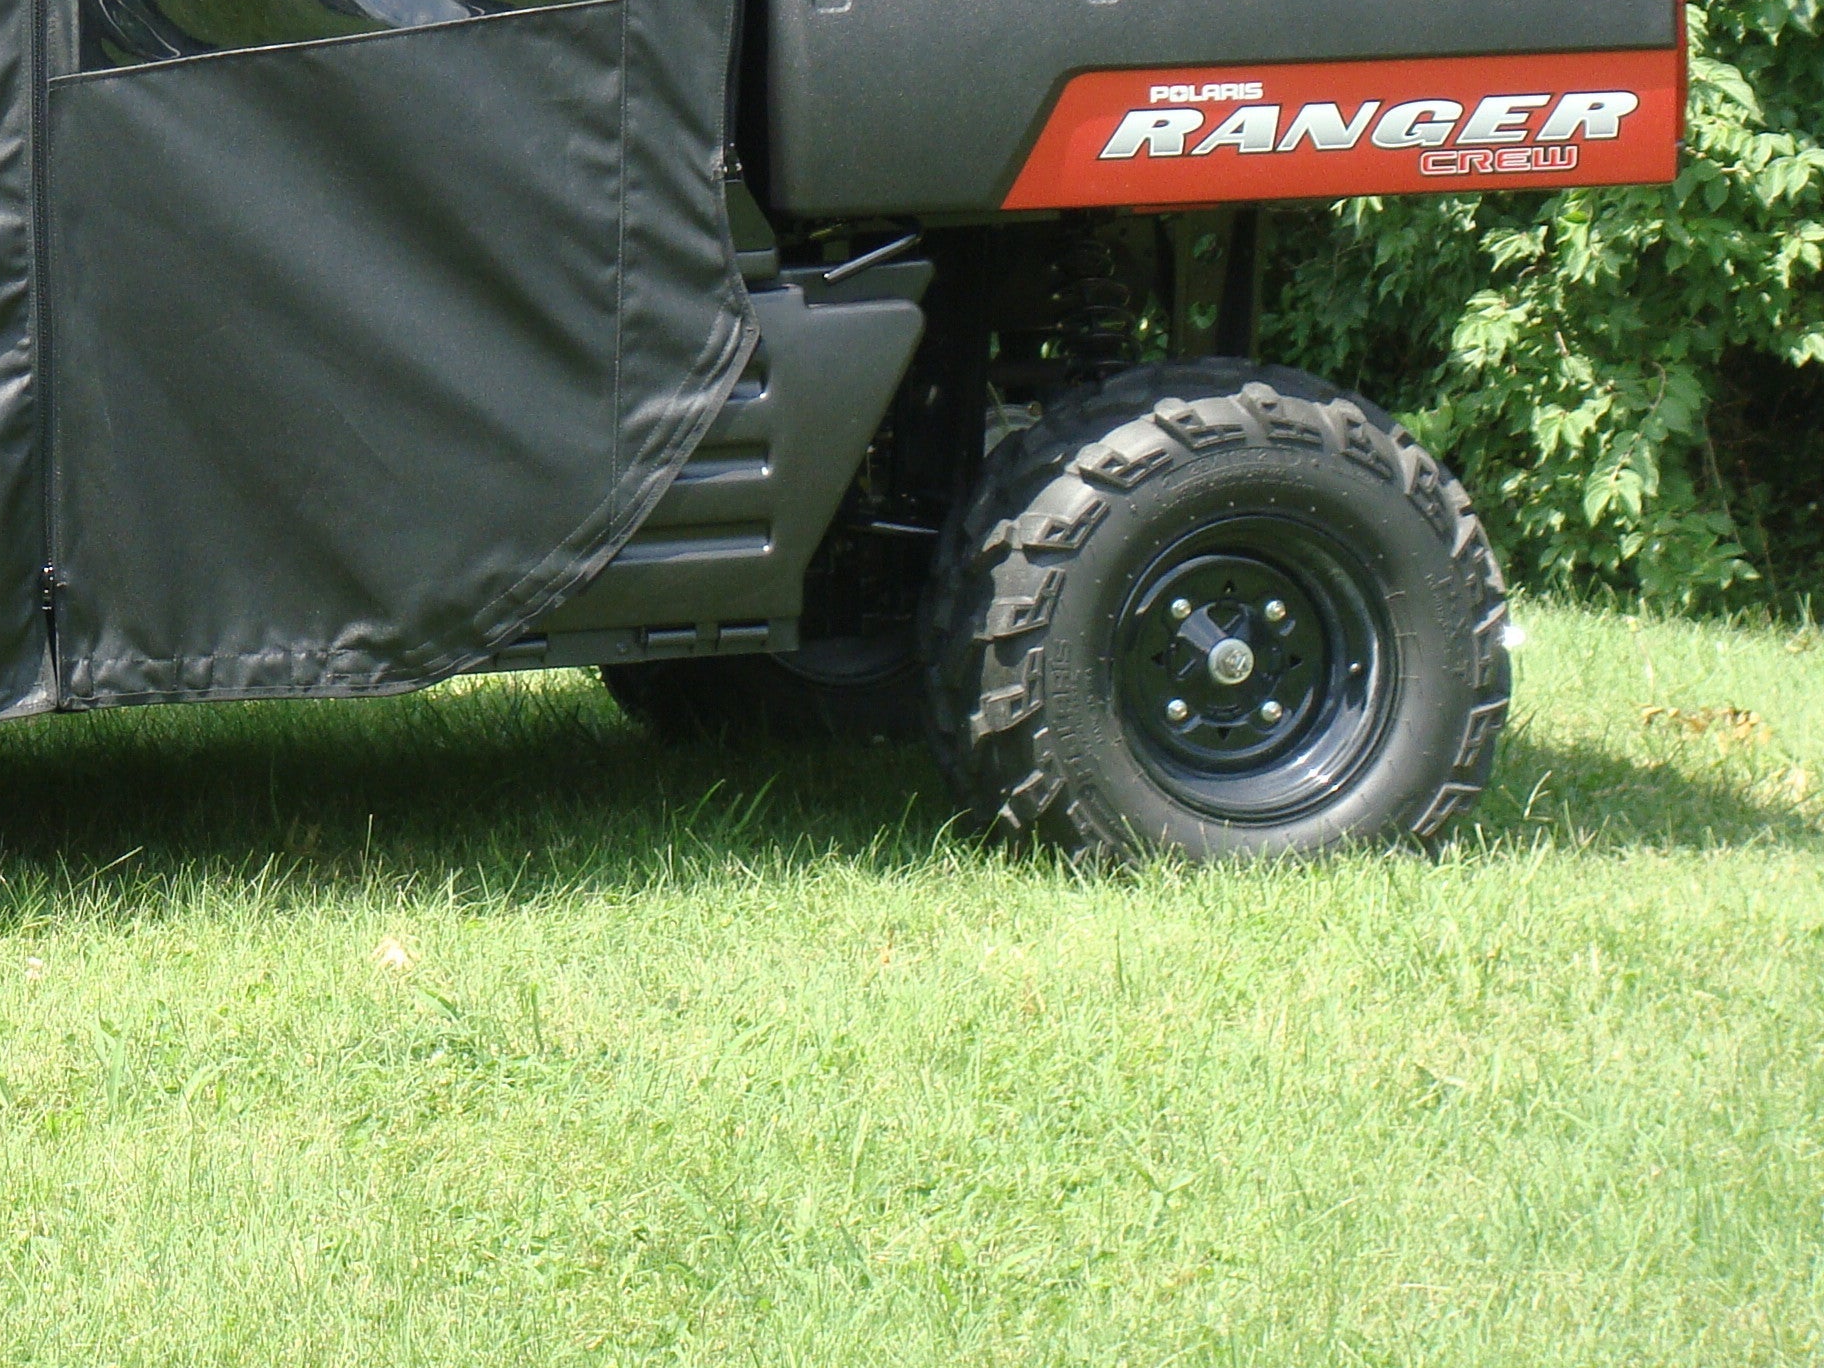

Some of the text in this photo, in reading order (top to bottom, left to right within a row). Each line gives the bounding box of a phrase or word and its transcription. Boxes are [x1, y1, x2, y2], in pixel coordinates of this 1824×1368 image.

[1150, 82, 1264, 103] POLARIS
[1099, 90, 1640, 159] RANGER
[1420, 145, 1579, 177] CREW
